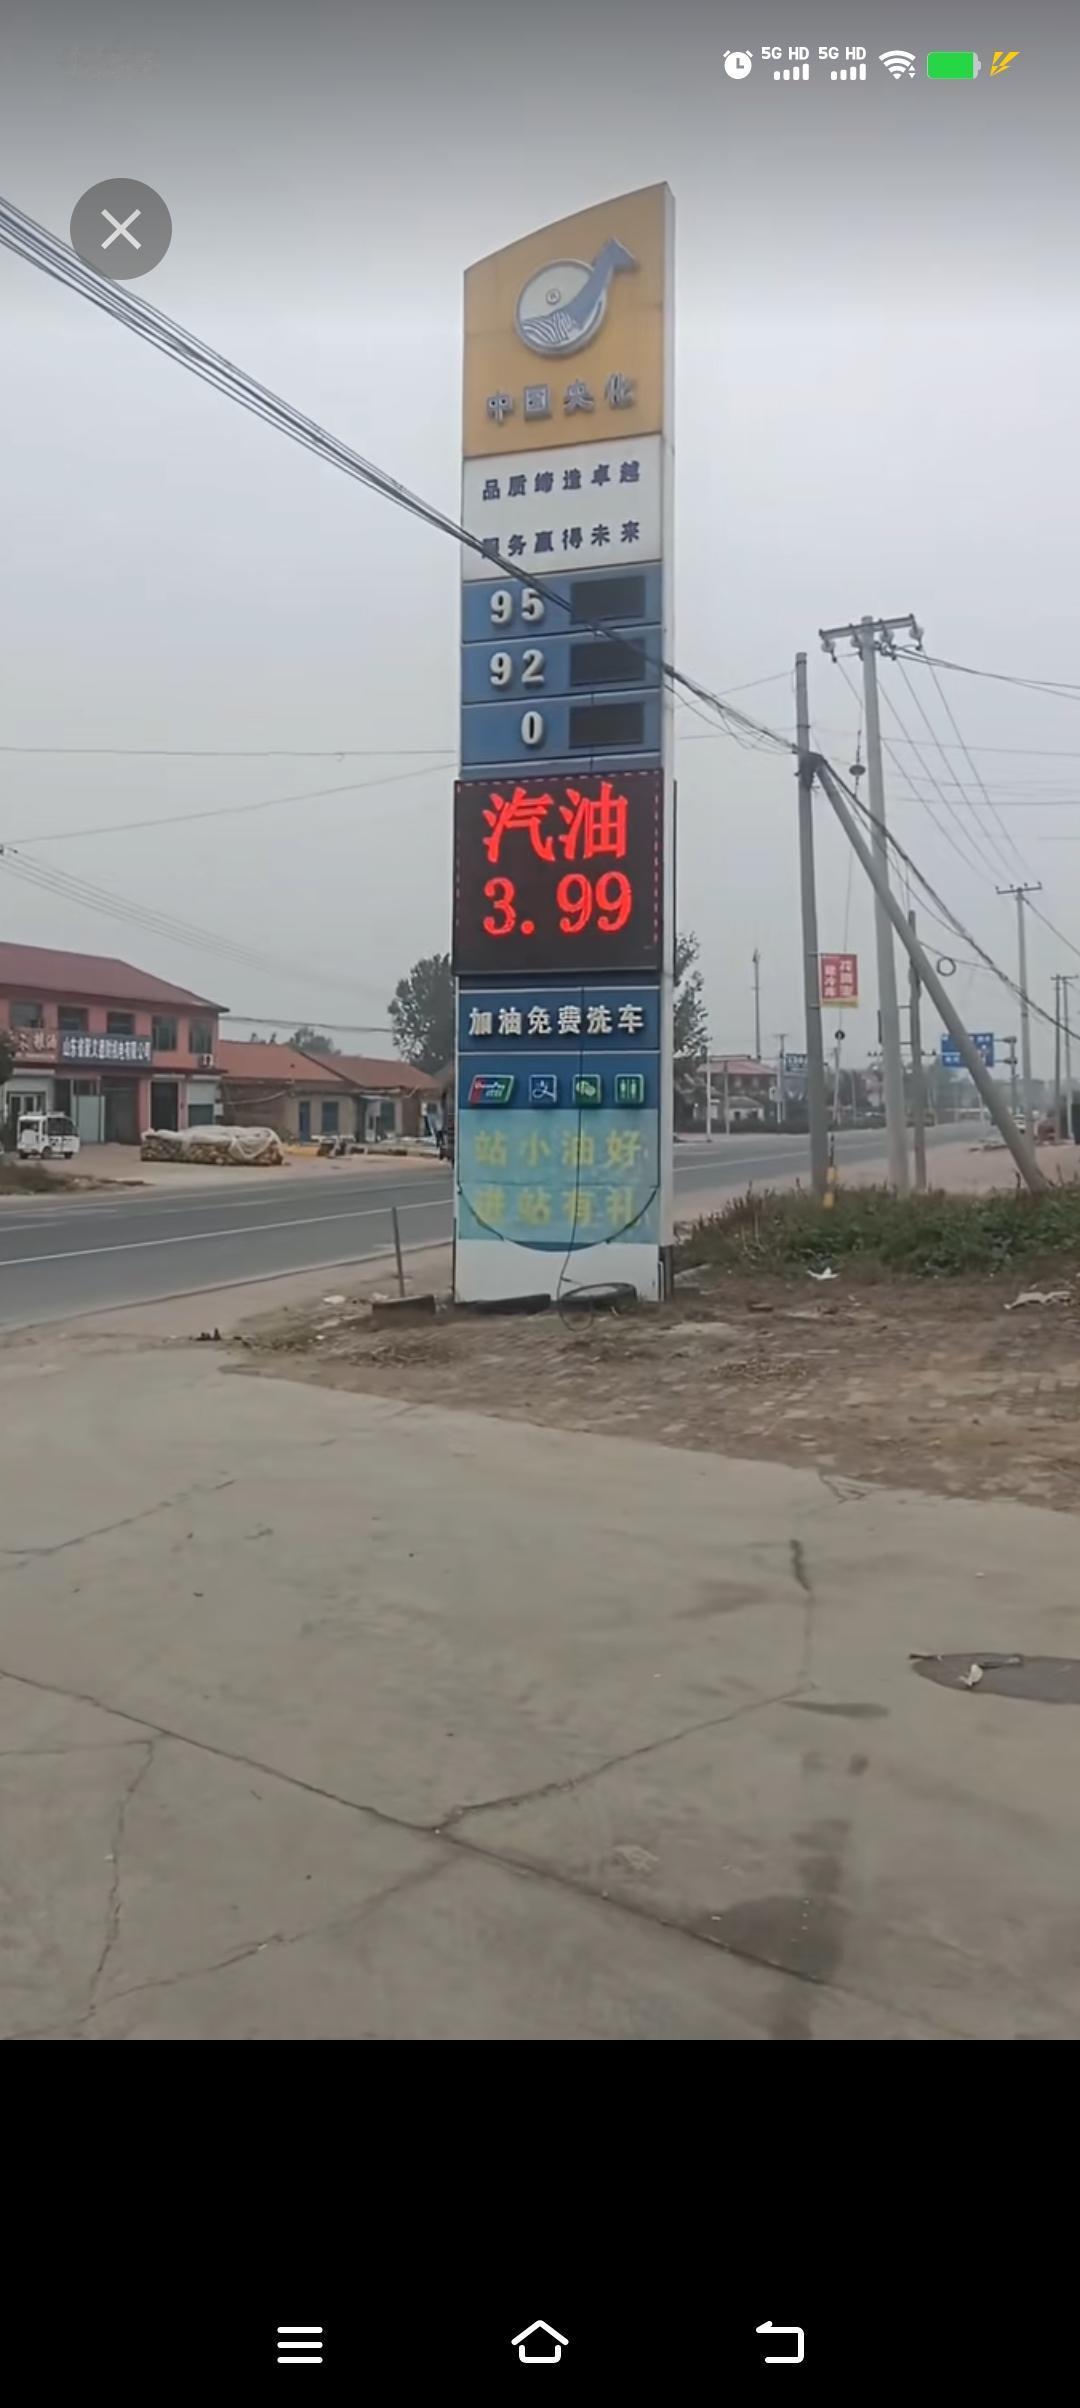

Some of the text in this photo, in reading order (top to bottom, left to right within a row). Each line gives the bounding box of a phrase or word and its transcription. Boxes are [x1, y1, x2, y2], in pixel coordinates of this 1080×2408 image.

[482, 460, 641, 501] 品质缔造卓越
[490, 587, 545, 626] 95
[490, 648, 545, 688] 92
[520, 710, 545, 746] 0
[482, 781, 630, 864] 汽油
[482, 871, 632, 936] 3.99
[469, 1003, 645, 1036] 加油免费洗车
[474, 1129, 642, 1168] 站小油好
